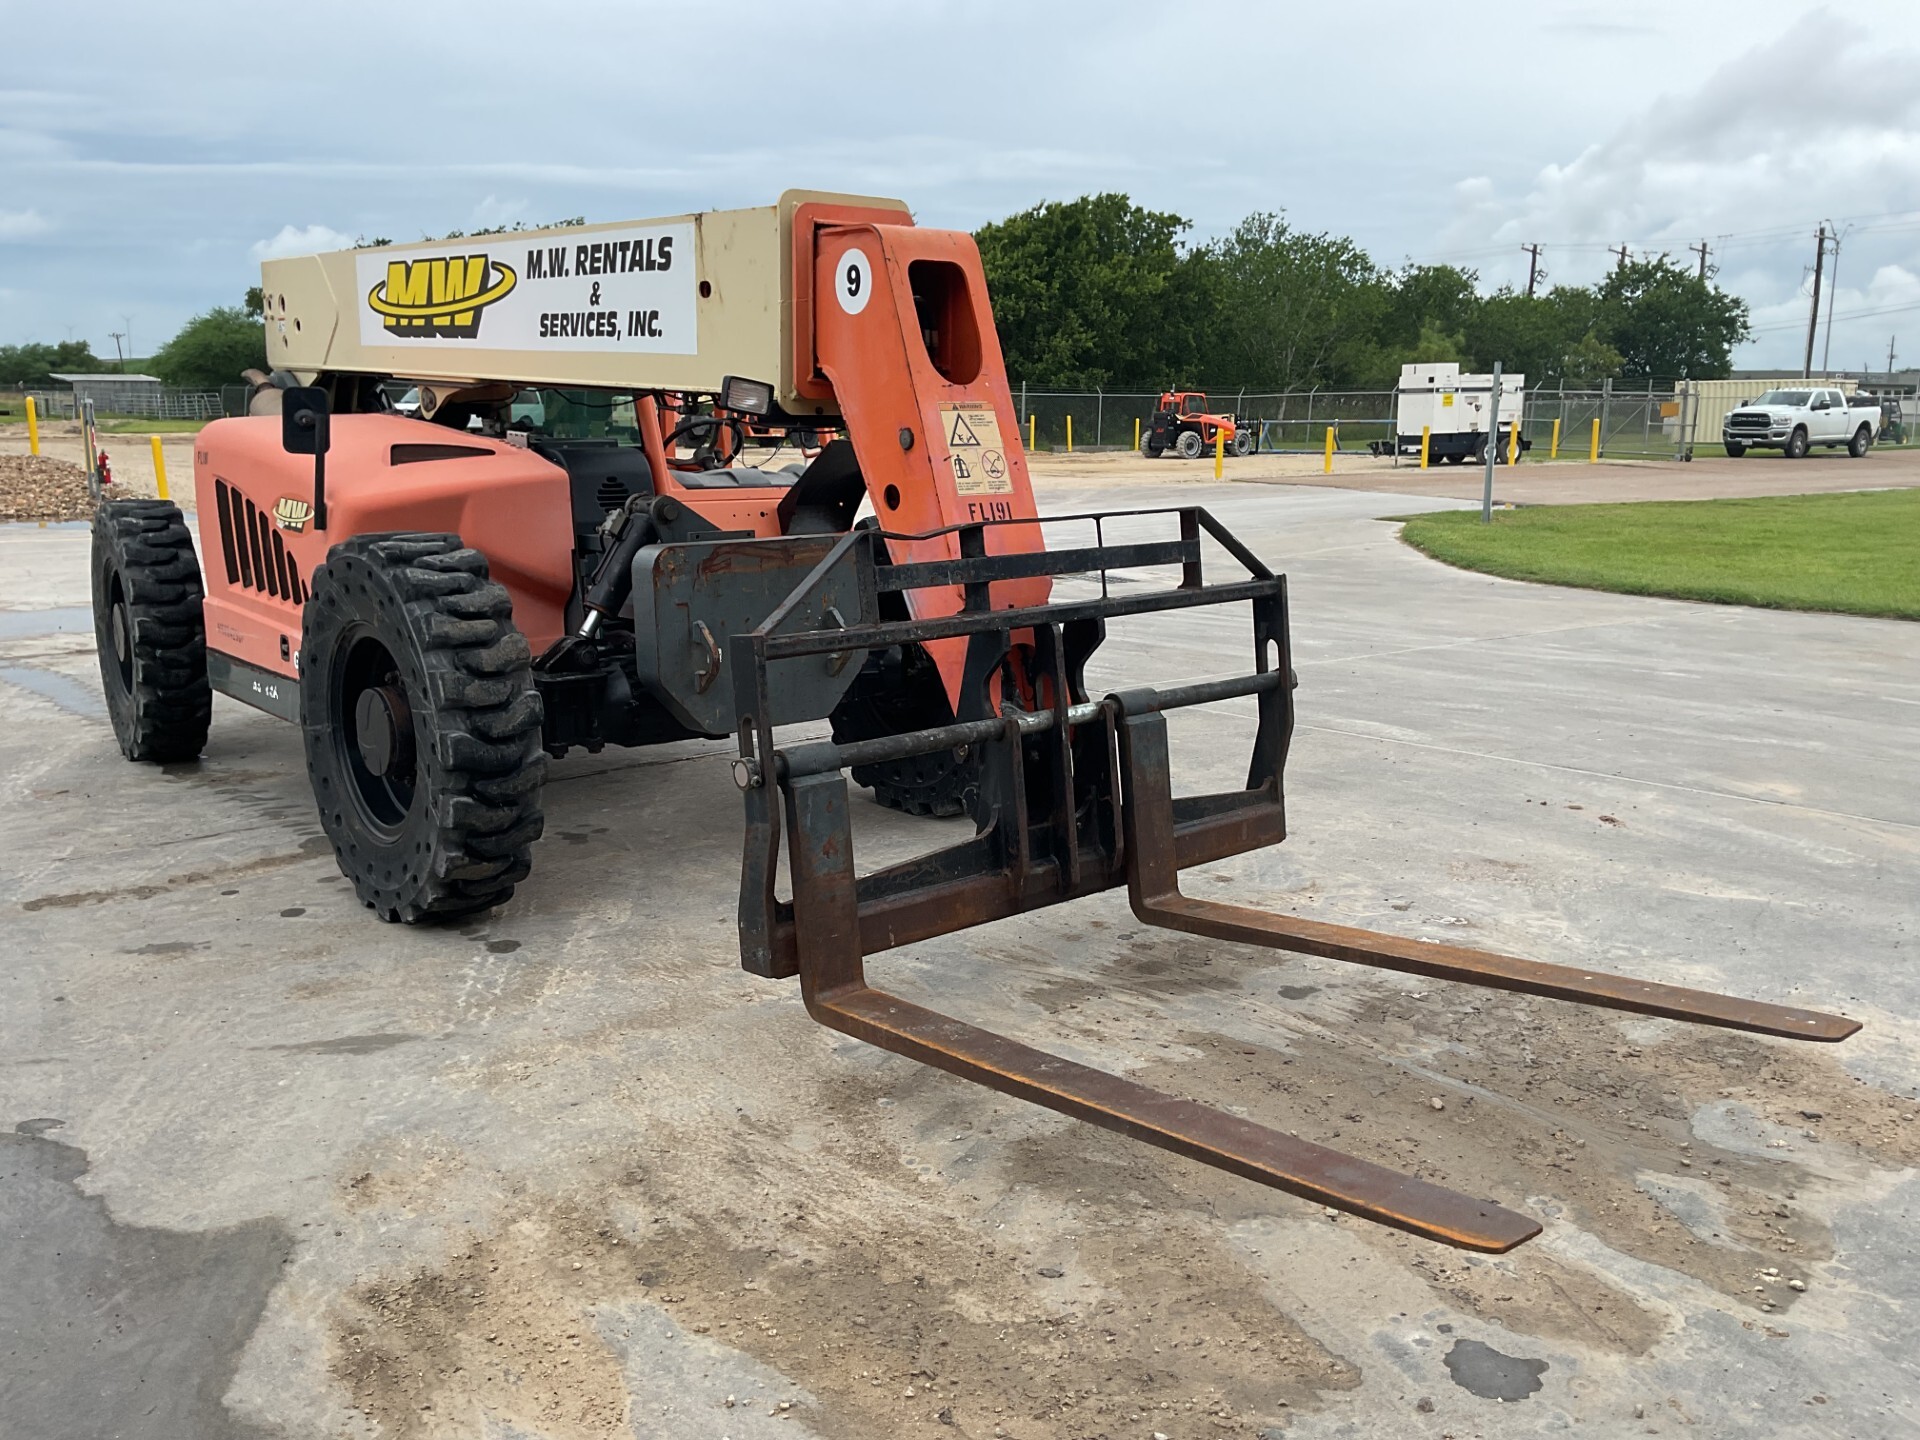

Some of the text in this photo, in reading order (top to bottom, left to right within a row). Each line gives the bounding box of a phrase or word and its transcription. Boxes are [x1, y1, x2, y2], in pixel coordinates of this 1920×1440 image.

[526, 236, 673, 279] M.W. RENTALS
[383, 253, 490, 339] MW
[590, 281, 601, 306] &
[846, 264, 861, 297] 9
[539, 310, 663, 341] SERVICES, INC.
